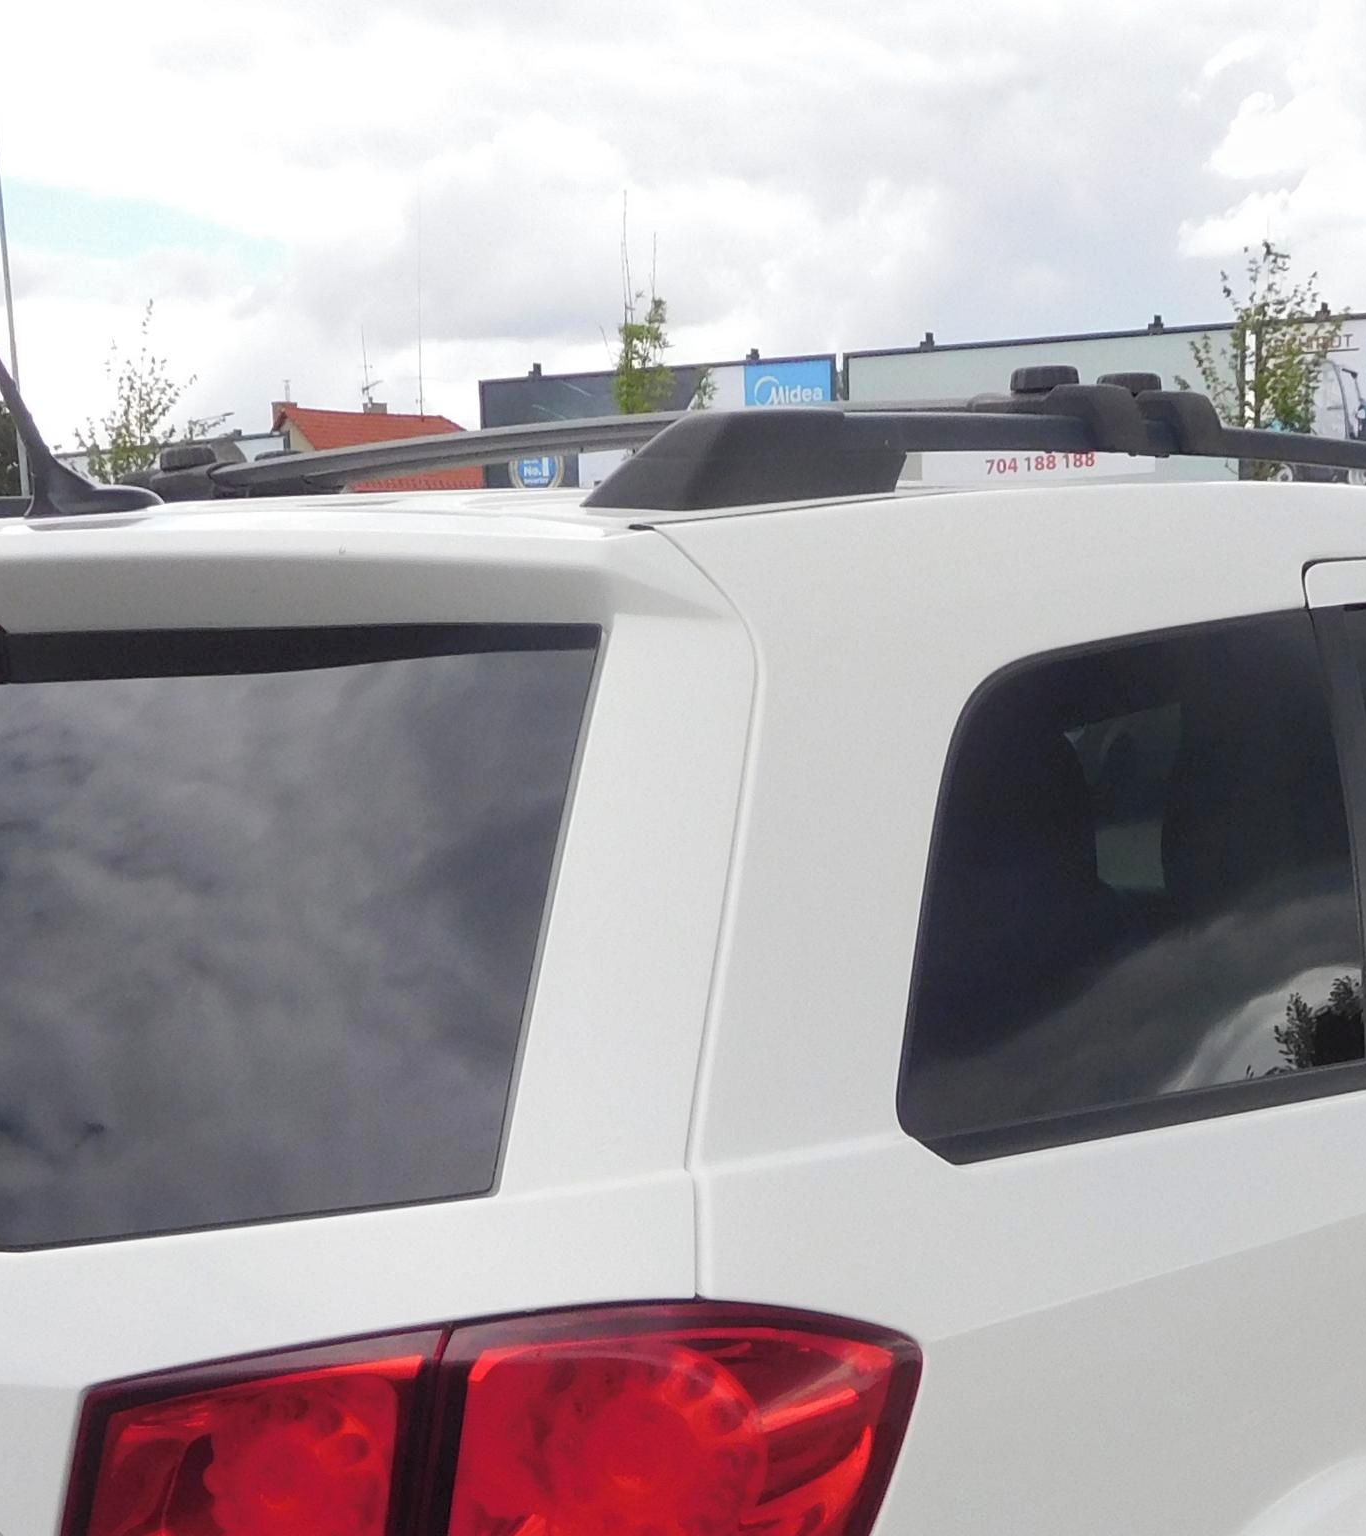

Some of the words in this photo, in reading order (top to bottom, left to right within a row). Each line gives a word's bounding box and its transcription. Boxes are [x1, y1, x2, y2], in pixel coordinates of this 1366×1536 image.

[764, 382, 823, 406] Midea
[985, 458, 1018, 475] 704
[1024, 455, 1056, 472] 188
[1063, 453, 1095, 469] 188
